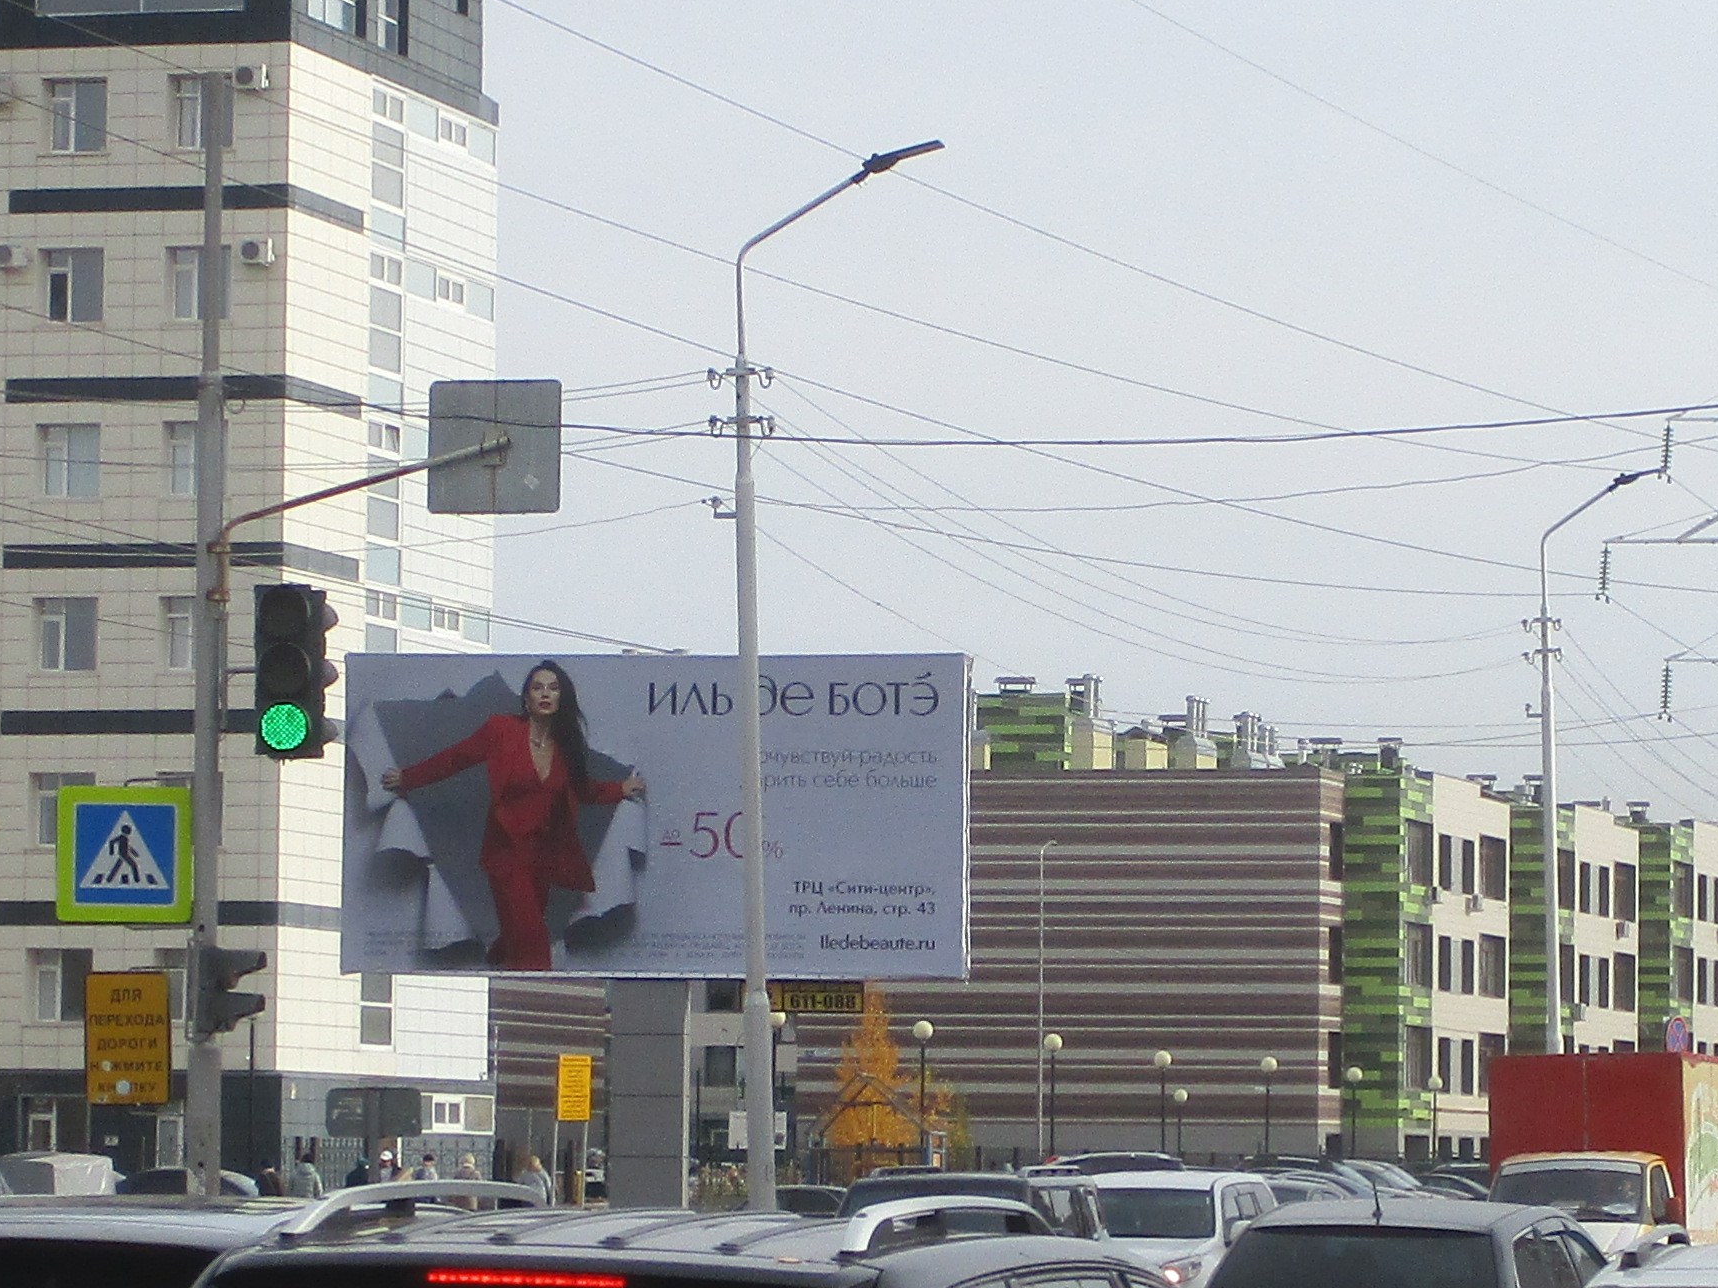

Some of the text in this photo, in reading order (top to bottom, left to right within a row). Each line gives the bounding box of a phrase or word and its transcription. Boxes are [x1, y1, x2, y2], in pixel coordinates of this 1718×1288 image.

[648, 681, 733, 716] ИЛЬ
[760, 749, 938, 769] очувствуй радость
[761, 769, 938, 790] рить себе больше
[794, 881, 824, 897] ТРЦ
[789, 902, 936, 916] пр. Ленина, стр. 43
[111, 988, 143, 1004] ДЛЯ
[89, 1013, 166, 1027] ПЕРЕХОДА
[97, 1037, 158, 1051] ДОРОГИ
[90, 1060, 163, 1072] НЖМИТЕ
[98, 1081, 156, 1093] КНПКУ
